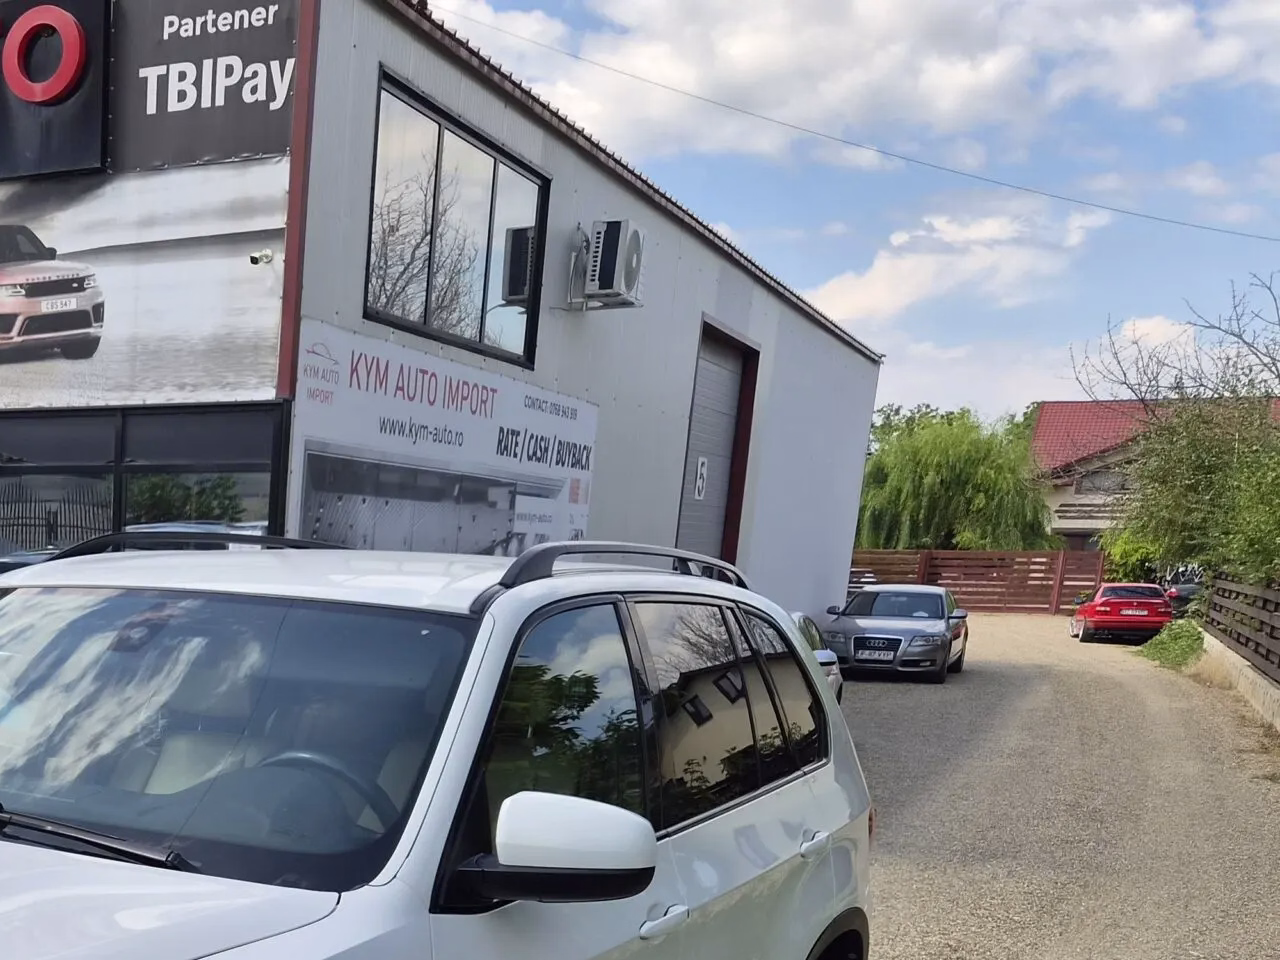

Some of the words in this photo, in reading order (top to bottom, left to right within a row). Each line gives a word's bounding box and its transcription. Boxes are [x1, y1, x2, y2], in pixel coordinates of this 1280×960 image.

[163, 4, 279, 40] Partener
[138, 55, 296, 116] TBIPay
[303, 363, 320, 380] KYM
[321, 368, 339, 385] AUTO
[349, 349, 389, 397] KYM
[394, 363, 438, 407] AUTO
[442, 375, 497, 419] IMPORT
[307, 387, 334, 405] IMPORT
[379, 416, 464, 448] www.kym-auto.ro
[496, 425, 520, 459] RATE
[519, 428, 528, 464] /
[527, 433, 550, 464] CASH
[549, 434, 557, 468] /
[555, 439, 592, 471] BUYBACK
[697, 461, 706, 498] 5
